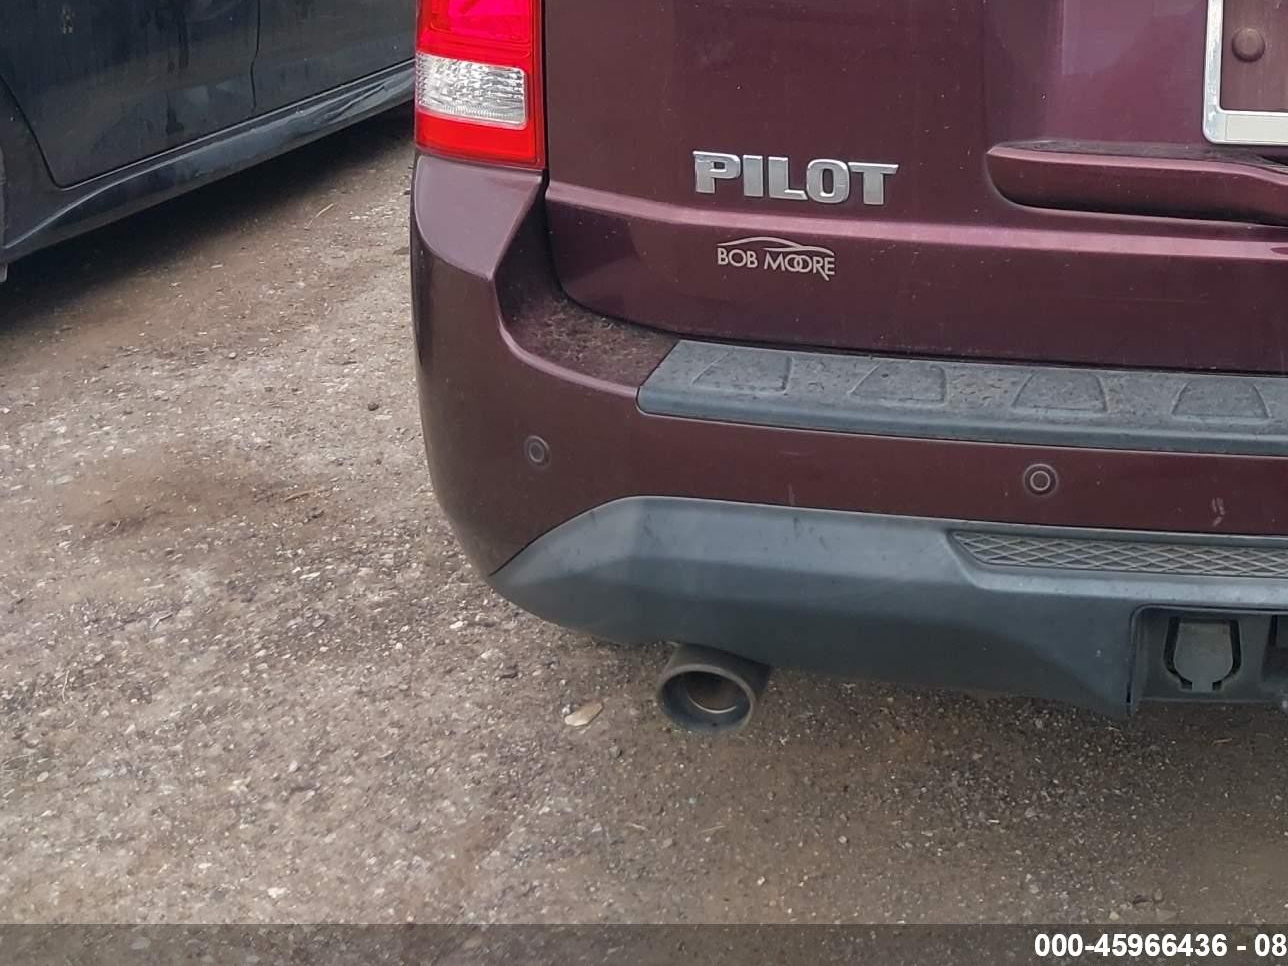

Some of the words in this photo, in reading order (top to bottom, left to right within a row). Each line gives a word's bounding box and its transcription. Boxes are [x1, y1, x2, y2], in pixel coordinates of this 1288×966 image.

[692, 150, 899, 205] PILOT
[717, 246, 758, 268] BOB
[763, 250, 835, 281] MOORE
